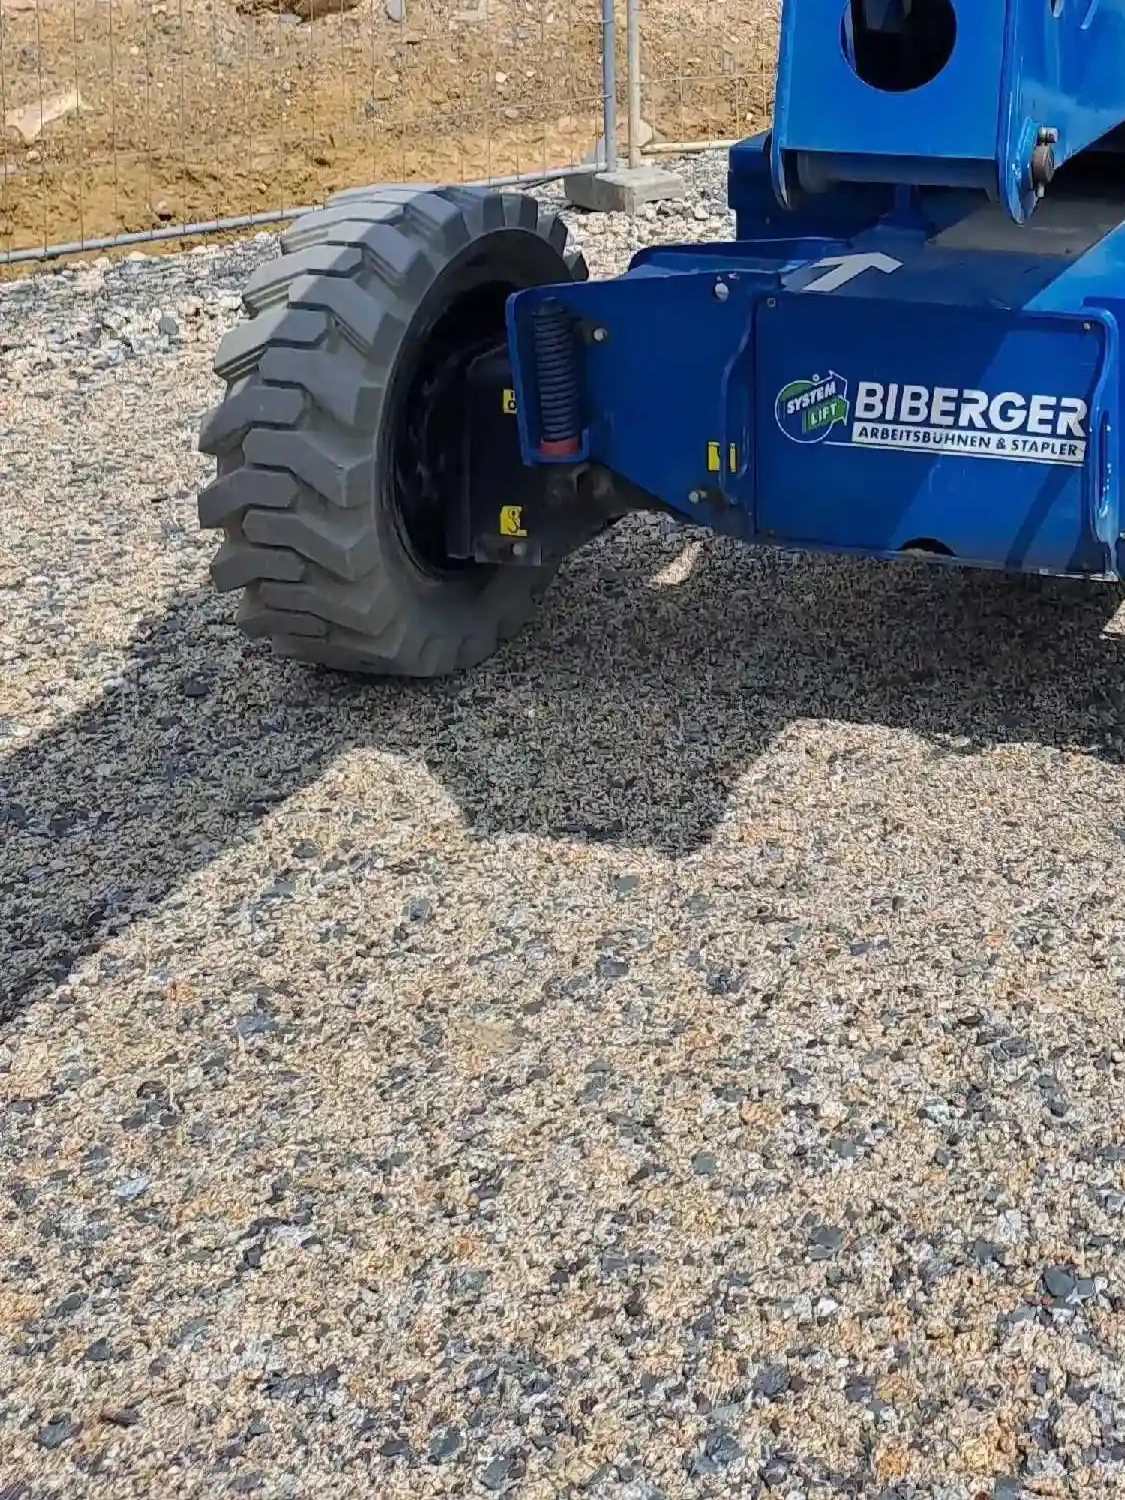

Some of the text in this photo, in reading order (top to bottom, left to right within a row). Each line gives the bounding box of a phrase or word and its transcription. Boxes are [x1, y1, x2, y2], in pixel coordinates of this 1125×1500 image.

[786, 380, 836, 415] SYSTEM
[854, 381, 1088, 438] BIBERGER
[810, 403, 837, 426] LIFT
[996, 437, 1006, 450] &
[1011, 438, 1079, 457] STAPLER
